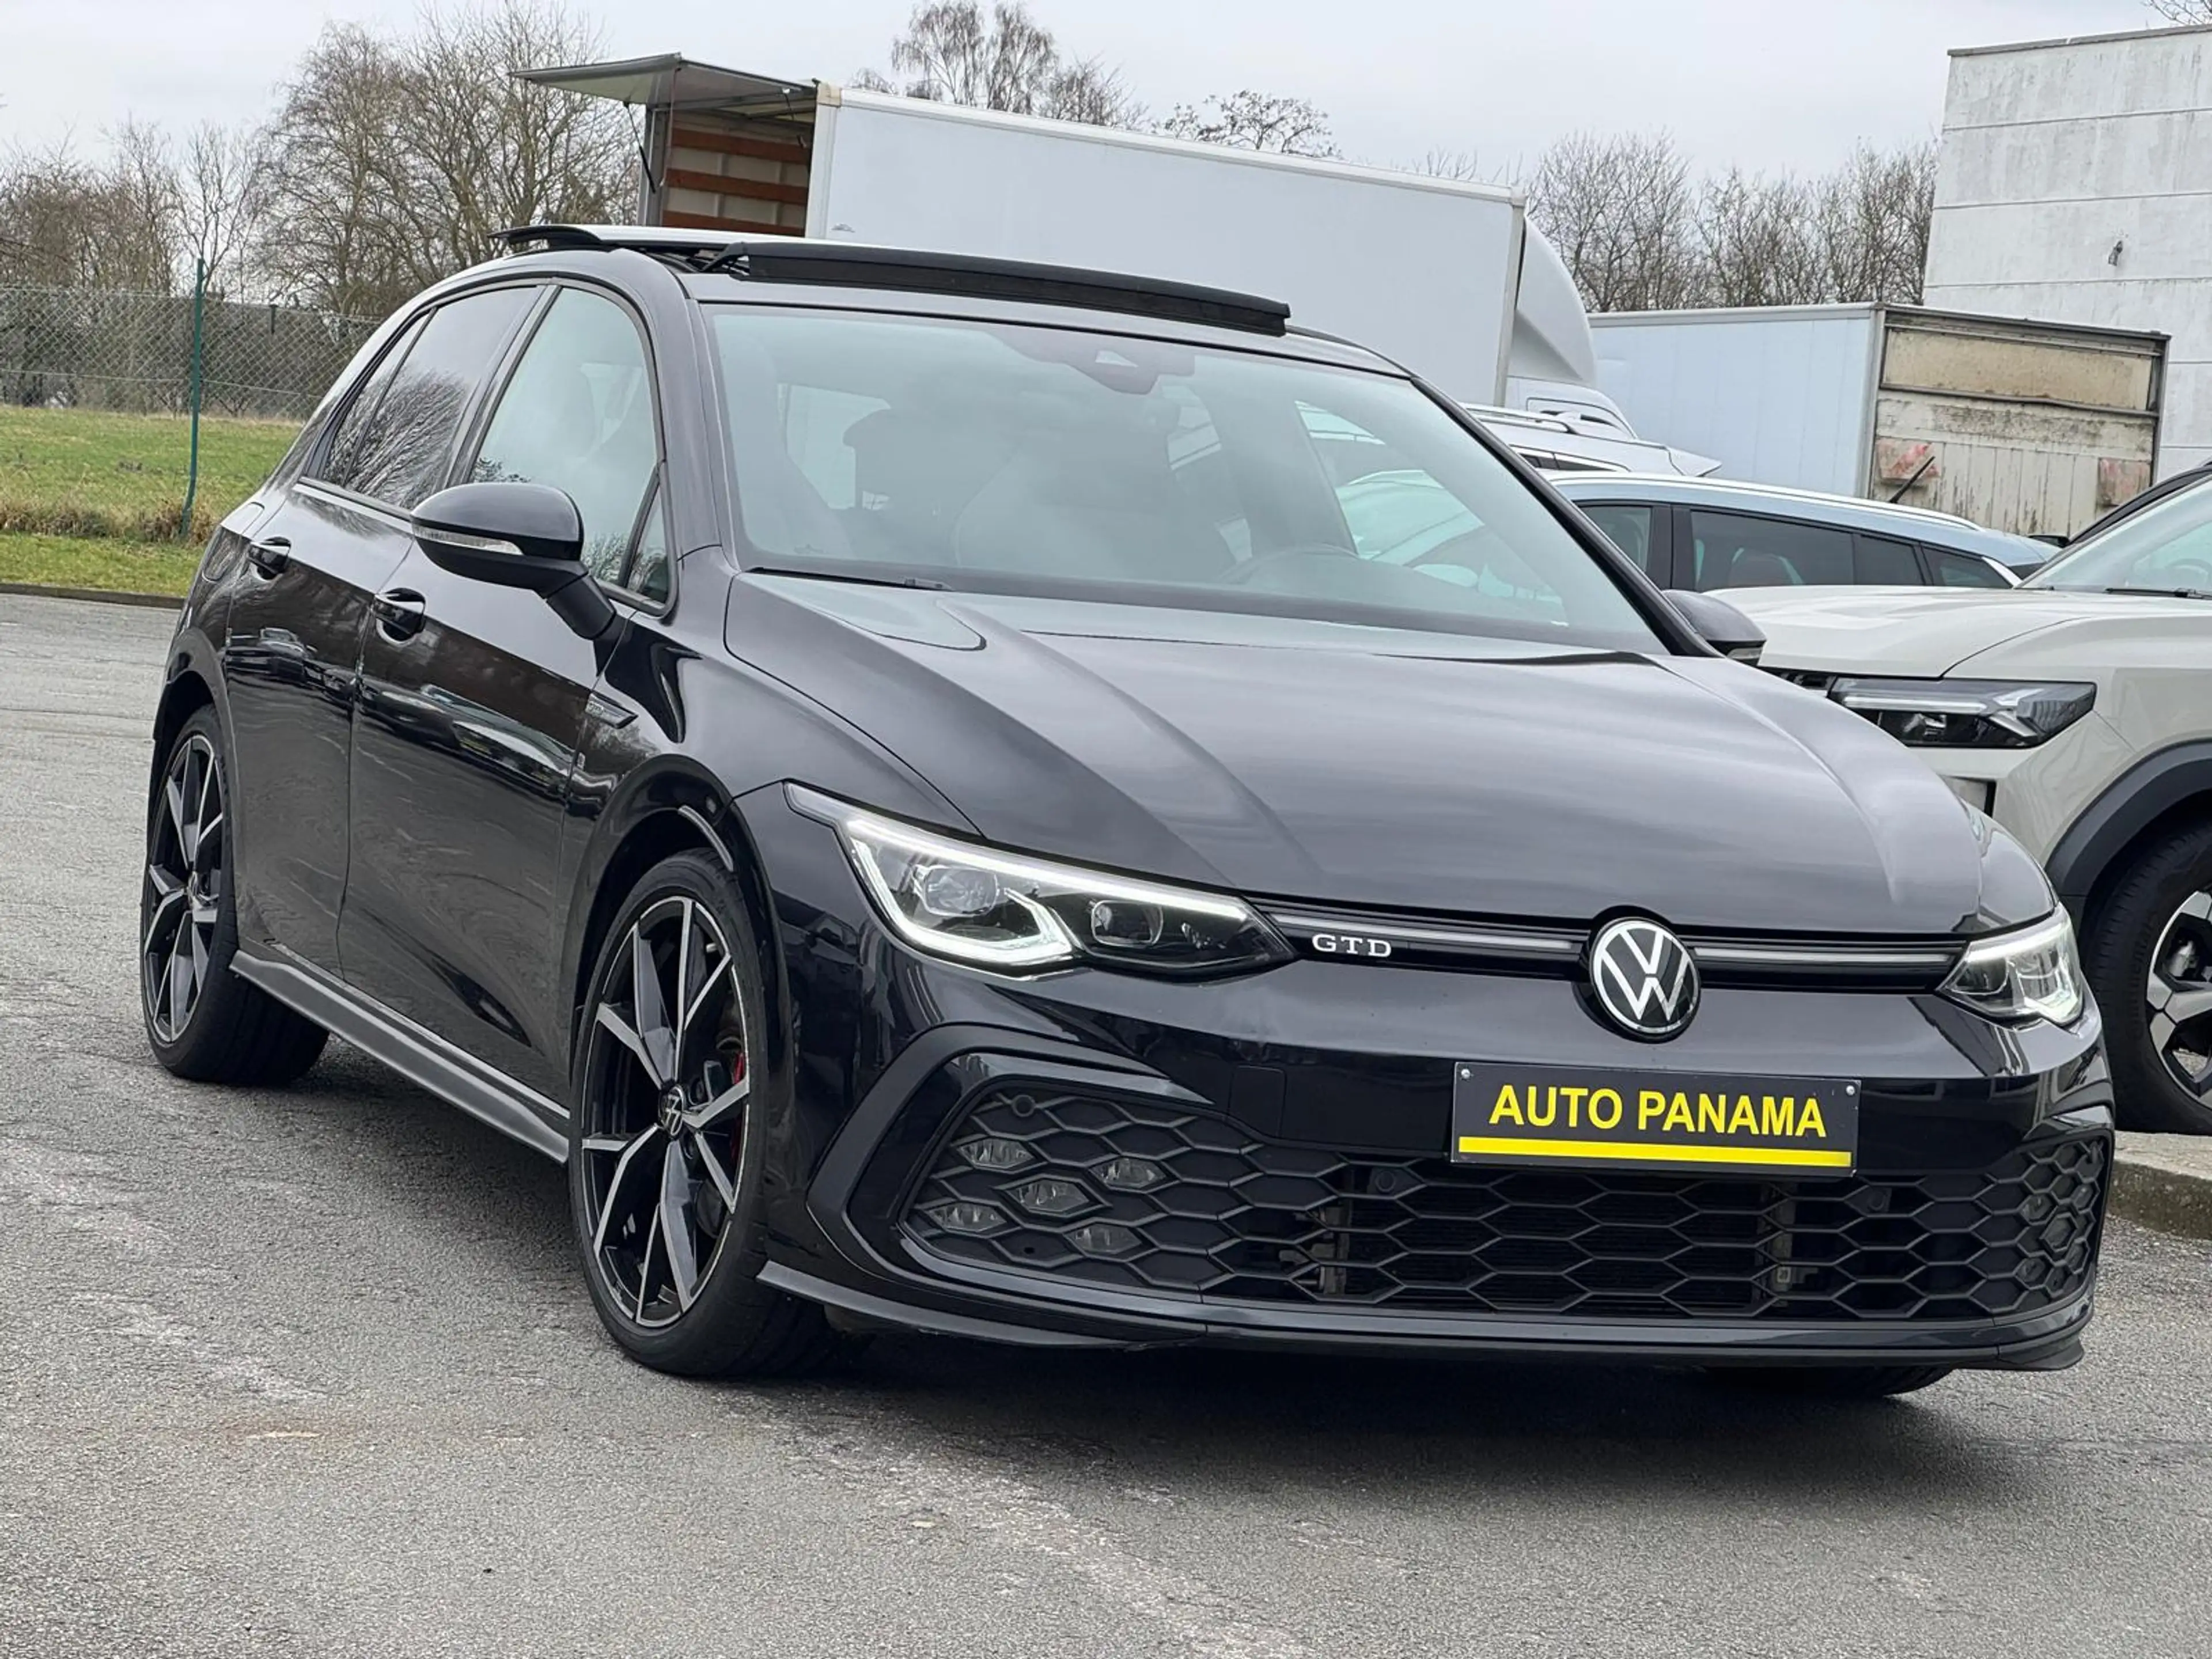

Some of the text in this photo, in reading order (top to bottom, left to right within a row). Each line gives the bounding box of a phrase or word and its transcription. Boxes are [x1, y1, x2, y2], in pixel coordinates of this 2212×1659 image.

[1311, 933, 1392, 958] GTD
[1488, 1084, 1827, 1138] AUTO PANAMA
